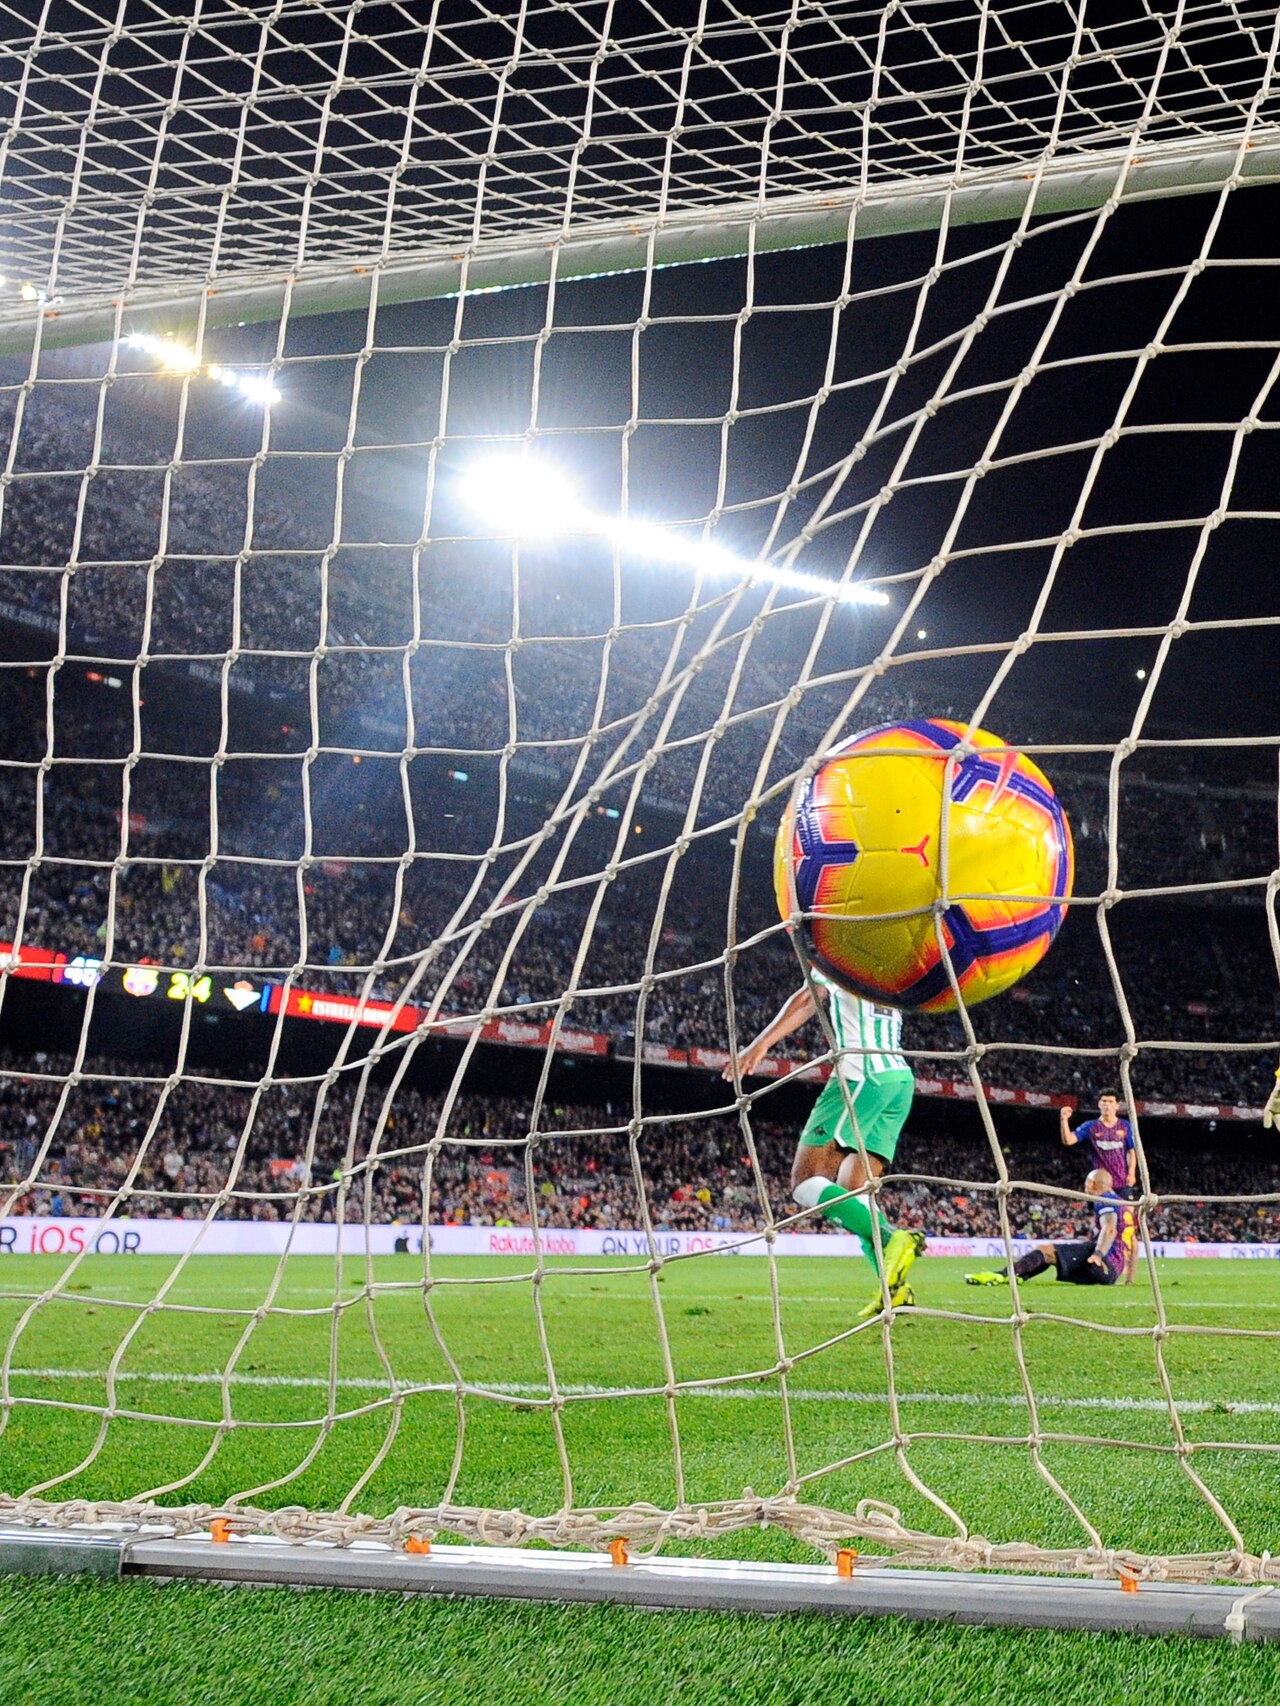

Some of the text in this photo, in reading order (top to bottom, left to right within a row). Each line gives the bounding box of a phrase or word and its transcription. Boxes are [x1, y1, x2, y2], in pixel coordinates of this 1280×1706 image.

[31, 1226, 85, 1254] iOS
[96, 1231, 141, 1254] OR
[602, 1237, 627, 1256] ON
